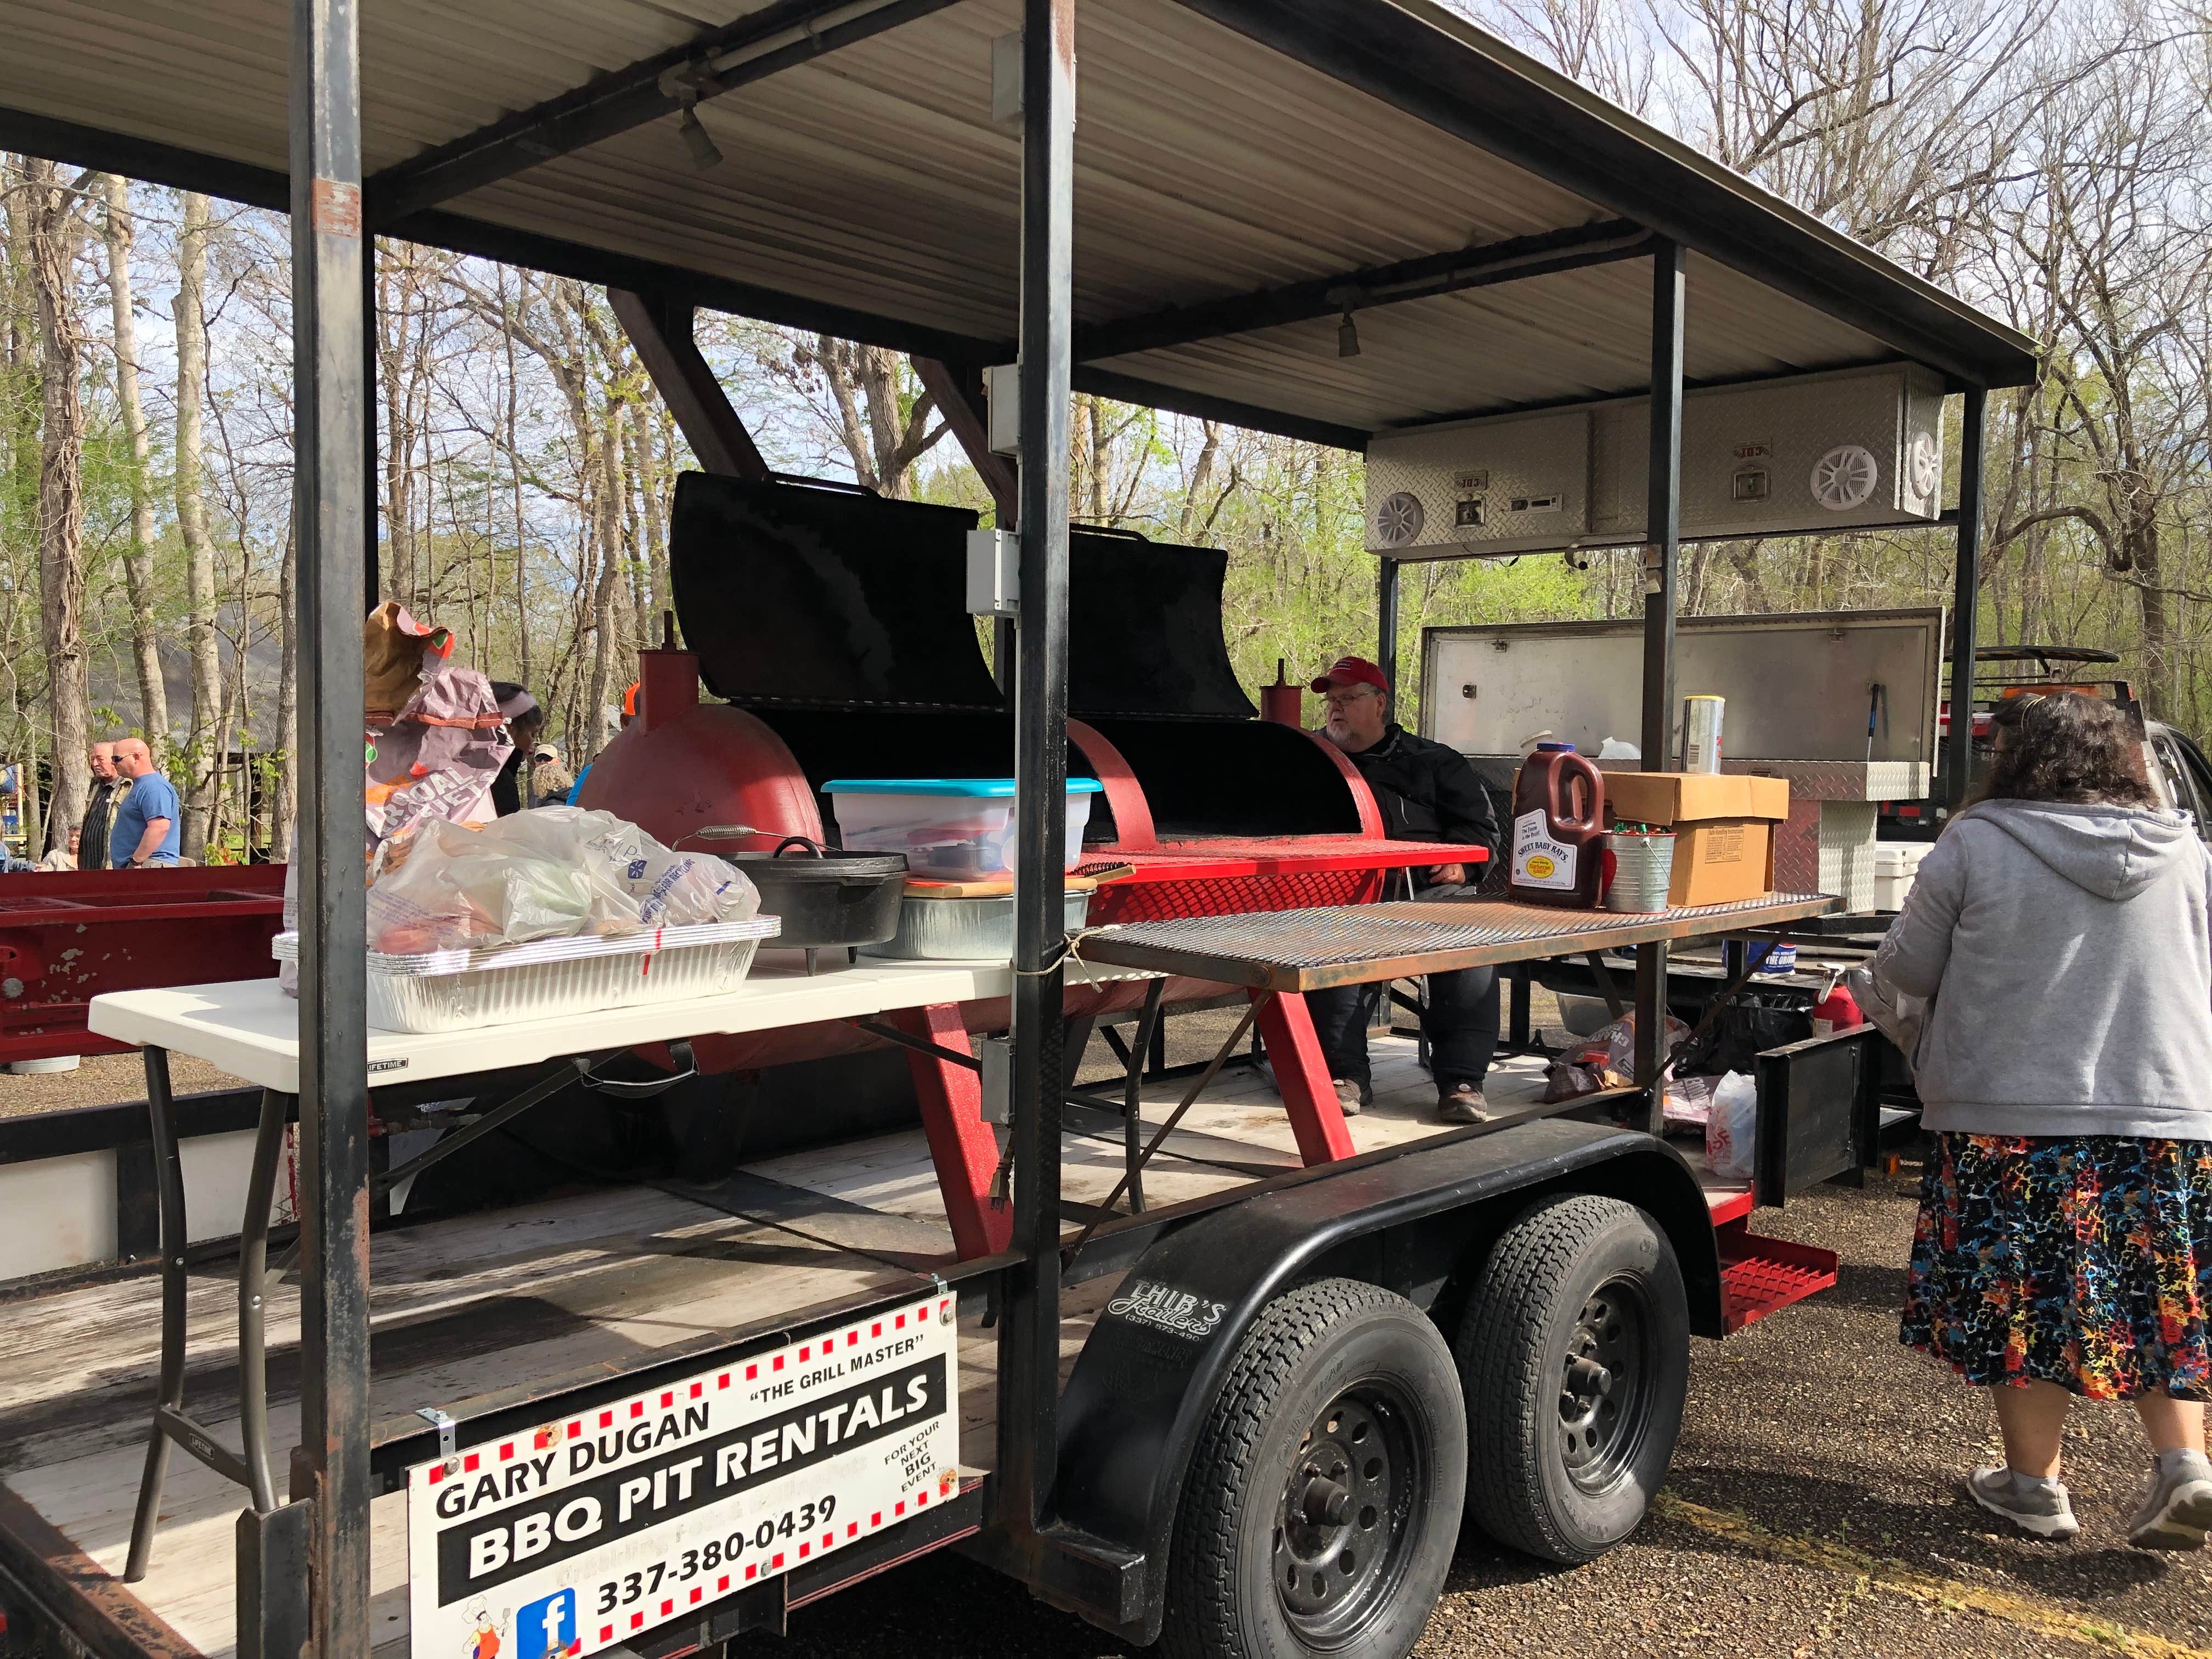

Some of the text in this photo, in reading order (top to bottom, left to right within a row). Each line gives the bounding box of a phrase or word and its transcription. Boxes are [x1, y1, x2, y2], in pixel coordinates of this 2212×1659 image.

[1518, 843, 1534, 857] SWEET
[1534, 842, 1551, 850] BABY
[1551, 845, 1569, 861] RAY'S
[669, 859, 696, 881] RECYCLING
[1125, 1313, 1203, 1342] (337) 873-490
[800, 1363, 845, 1390] GRILL
[884, 1421, 940, 1465] FOR YOUR
[901, 1440, 929, 1466] NEXT
[436, 1401, 709, 1519] GARY DUGAN
[905, 1452, 931, 1478] BIG
[469, 1496, 602, 1579] BBQ
[619, 1455, 703, 1523] PIT
[715, 1374, 928, 1487] RENTALS
[901, 1462, 937, 1493] EVENT
[597, 1494, 836, 1615] 337-380-0439
